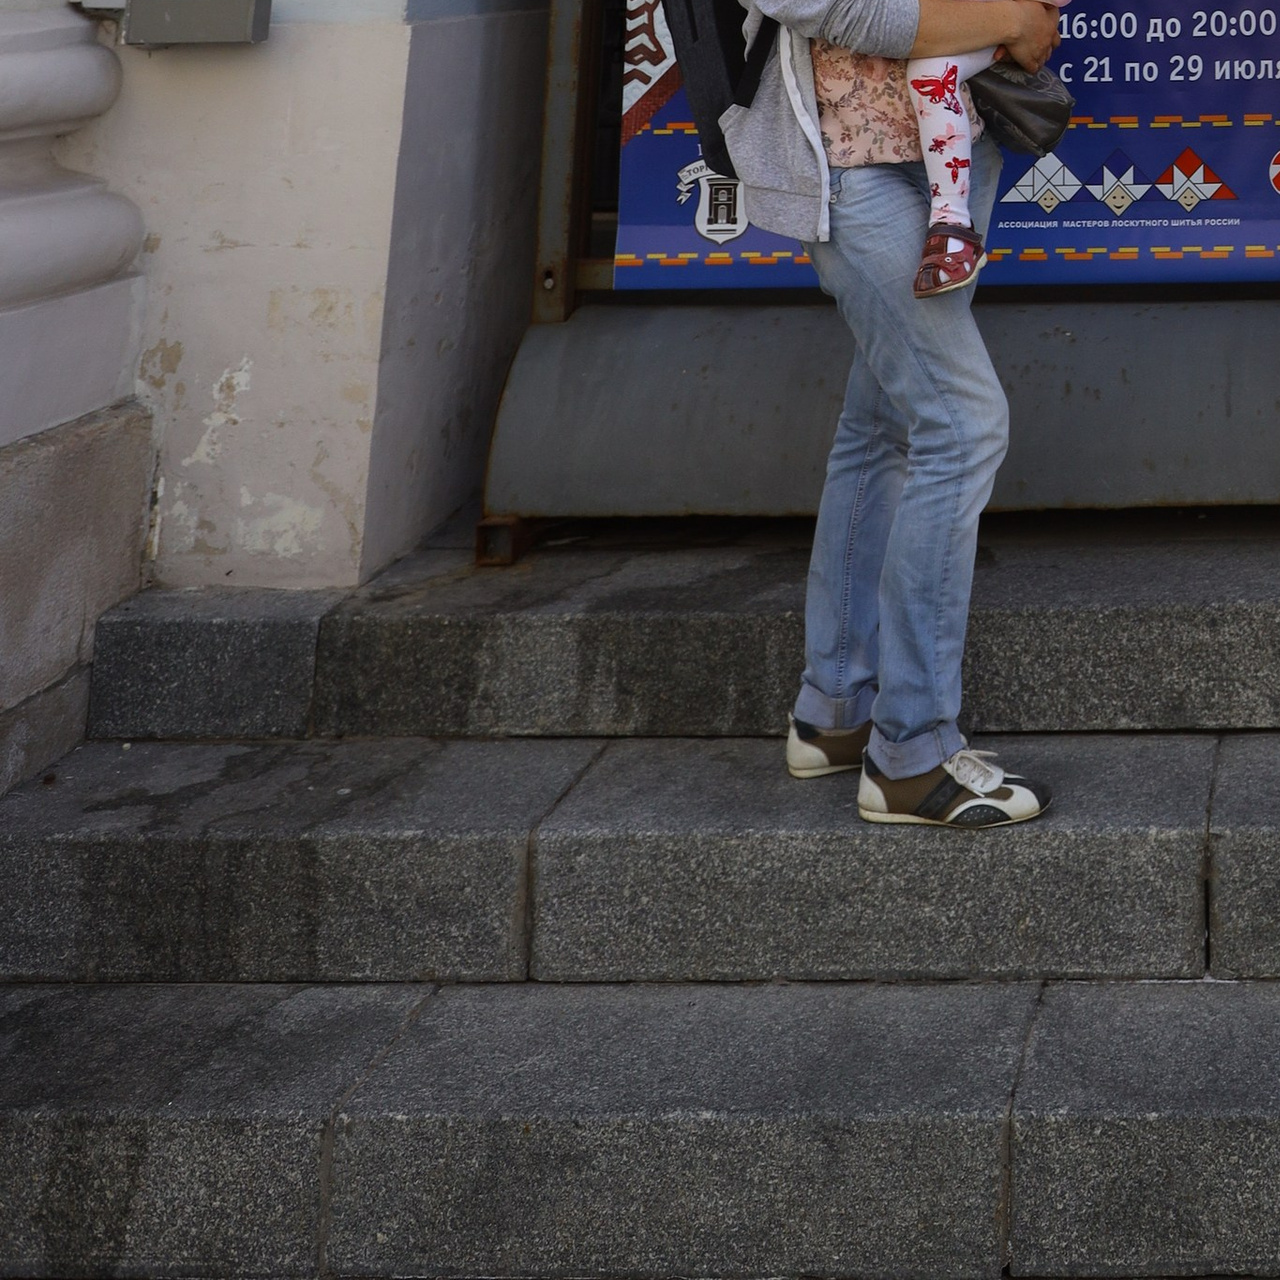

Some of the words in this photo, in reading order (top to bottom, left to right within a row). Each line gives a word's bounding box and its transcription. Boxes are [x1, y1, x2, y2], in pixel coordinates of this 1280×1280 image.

[1059, 11, 1138, 39] 16:00
[1146, 17, 1181, 43] до
[1192, 10, 1277, 37] 20:00
[1059, 62, 1073, 82] с
[1083, 56, 1113, 82] 21
[1124, 61, 1158, 82] по
[1169, 54, 1203, 81] 29
[998, 220, 1058, 229] АССОЦИАЦИЯ
[1062, 220, 1109, 228] МАСТЕРОВ
[1111, 219, 1169, 228] ЛОСКУТНОГО
[1171, 219, 1203, 227] ШИТЬЯ
[1204, 218, 1240, 226] РОССИИ
